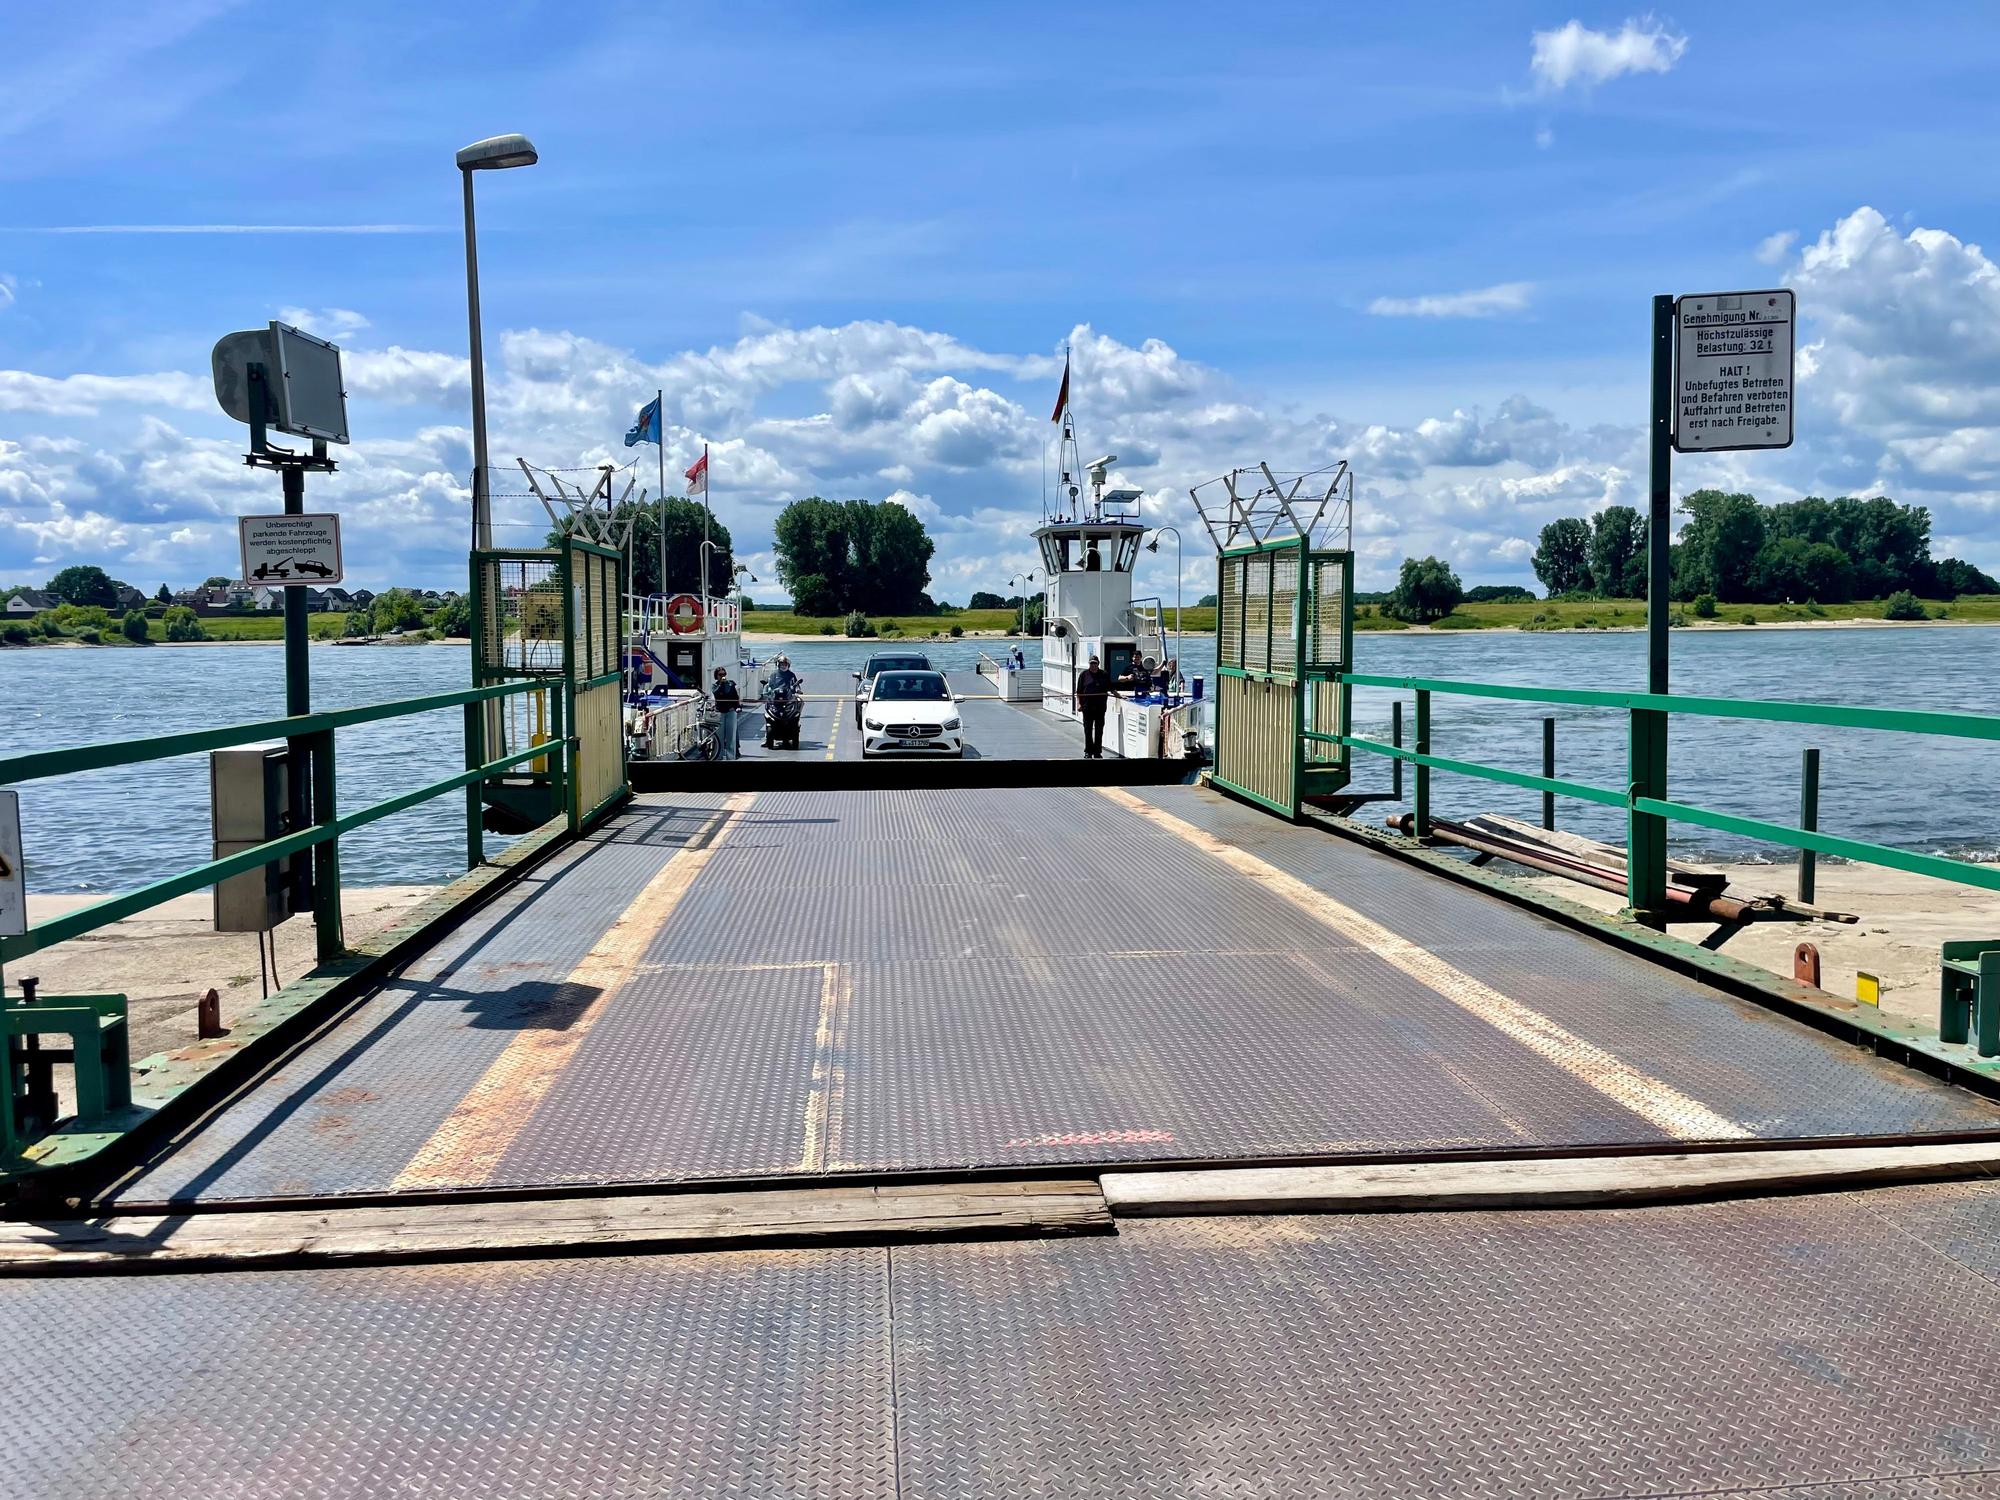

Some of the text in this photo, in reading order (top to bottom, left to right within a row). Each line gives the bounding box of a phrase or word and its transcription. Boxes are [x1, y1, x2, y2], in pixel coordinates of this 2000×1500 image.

[1683, 312, 1746, 326] Genehmigung
[1749, 310, 1762, 321] Nr.
[1697, 327, 1774, 341] Höchstzulässige
[1697, 341, 1746, 354] Belastung:
[1750, 340, 1764, 350] 32
[1719, 365, 1744, 377] HALT
[1685, 377, 1784, 391] Unbefugtes Betreten
[1681, 390, 1788, 404] und Befahren verboten
[1683, 402, 1786, 416] Auffahrt und Betreten
[1689, 415, 1780, 429] erst nach Freigabe.
[252, 529, 327, 538] parkende Fahrzeuge
[278, 538, 332, 546] kostenpflichtig
